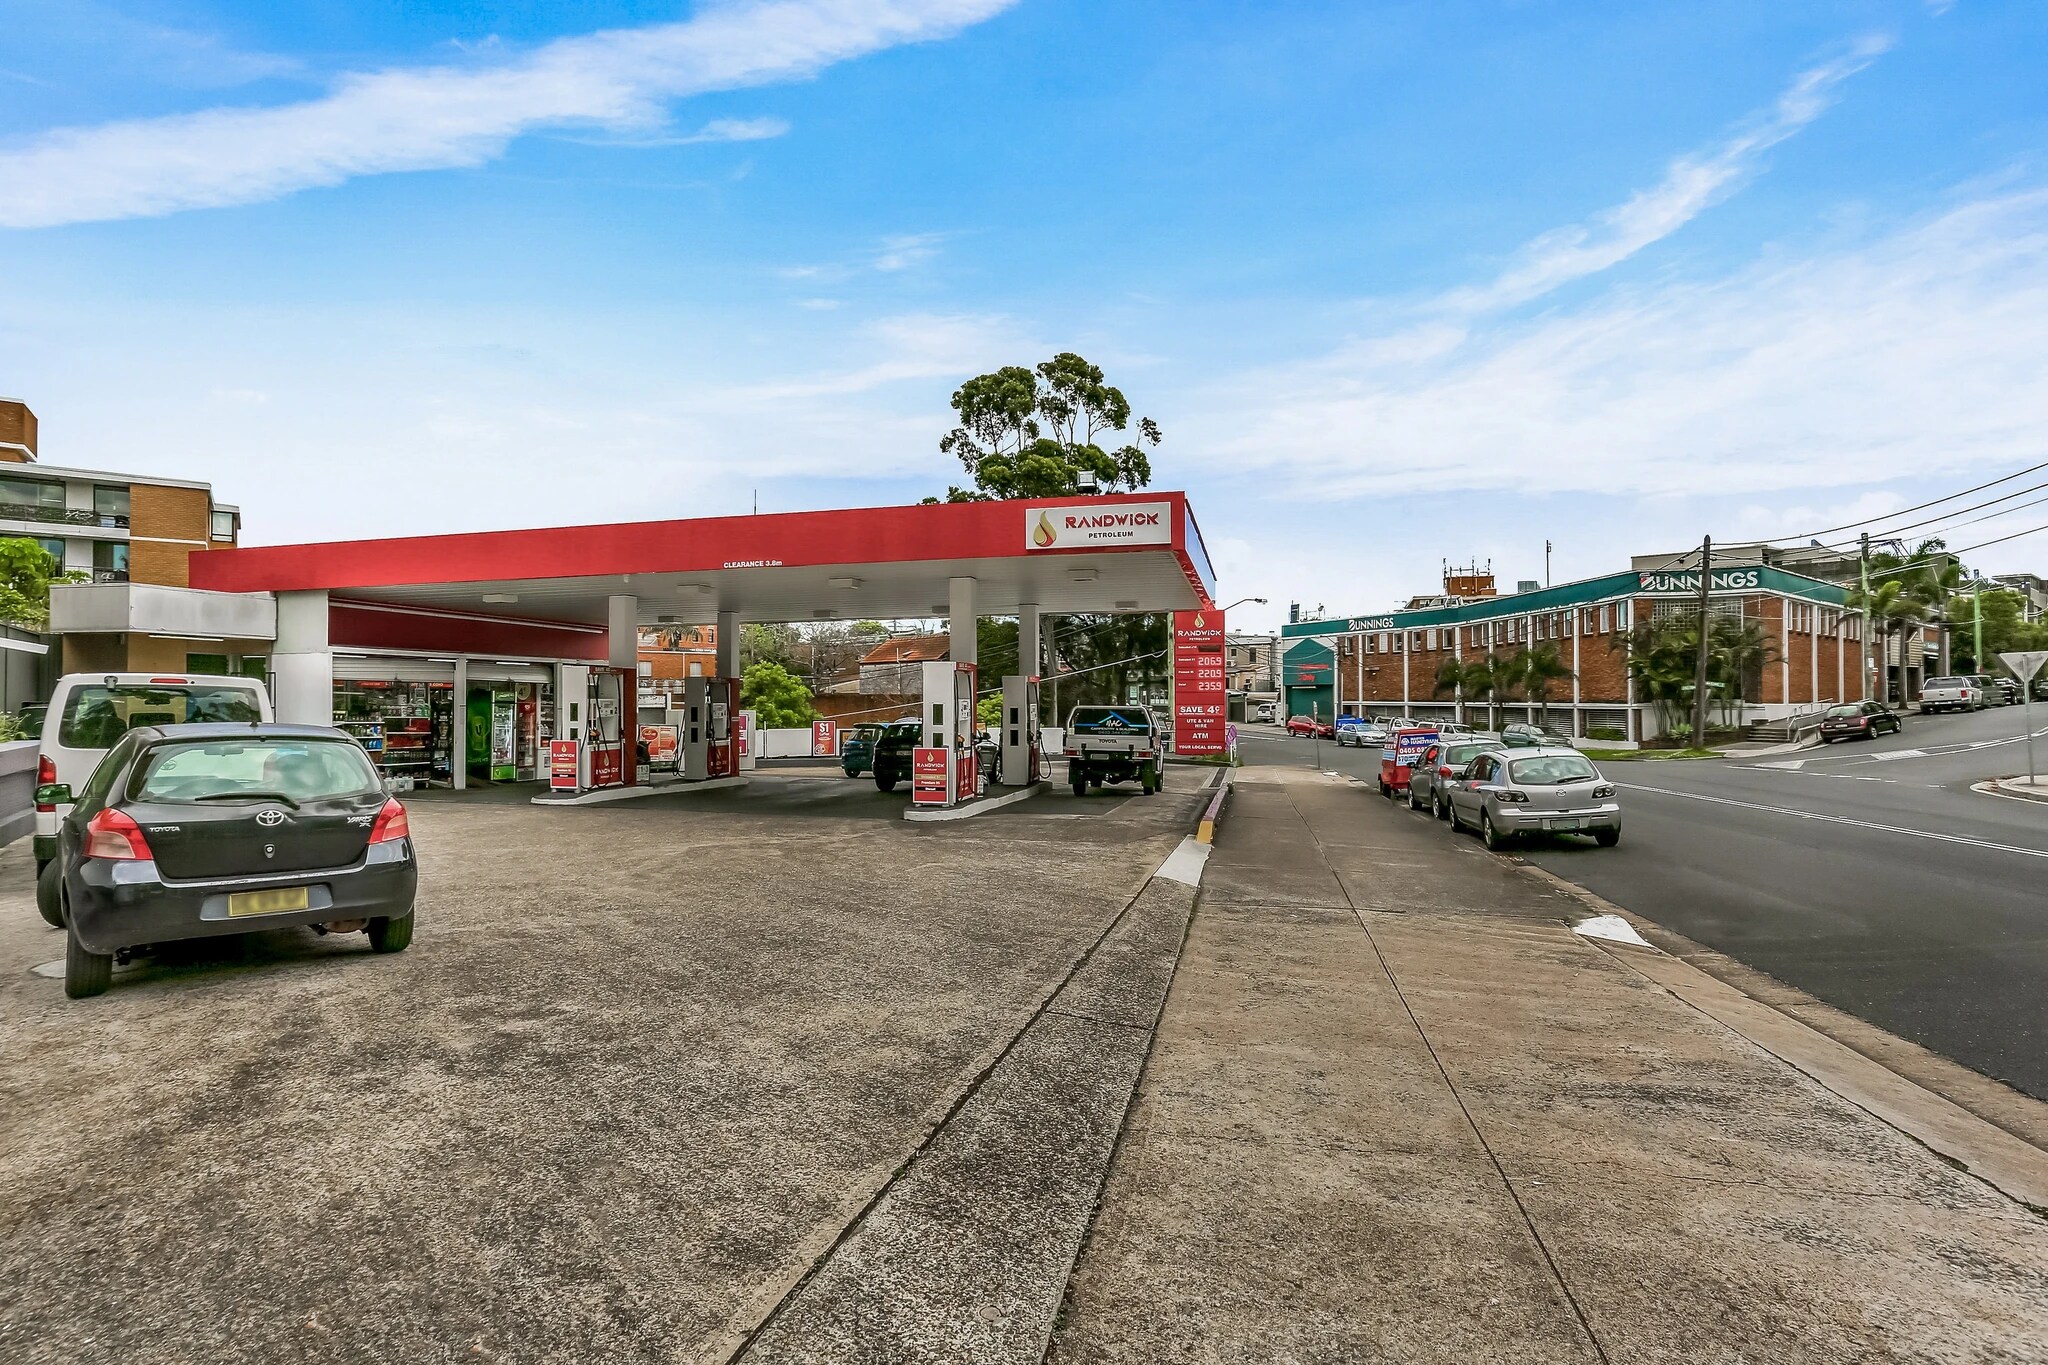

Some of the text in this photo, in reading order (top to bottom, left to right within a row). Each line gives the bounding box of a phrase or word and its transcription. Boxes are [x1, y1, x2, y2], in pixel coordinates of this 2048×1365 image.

[1065, 512, 1159, 529] RANDWICK
[1088, 531, 1134, 539] PETROLEUM
[723, 560, 764, 569] CLEARANCE
[1639, 571, 1759, 591] BUNNNGS
[1348, 617, 1394, 631] BUNNINGS
[1177, 629, 1222, 637] RANDWICK
[819, 722, 829, 733] $1
[346, 815, 373, 824] YARIS
[149, 825, 181, 833] TOYOTA
